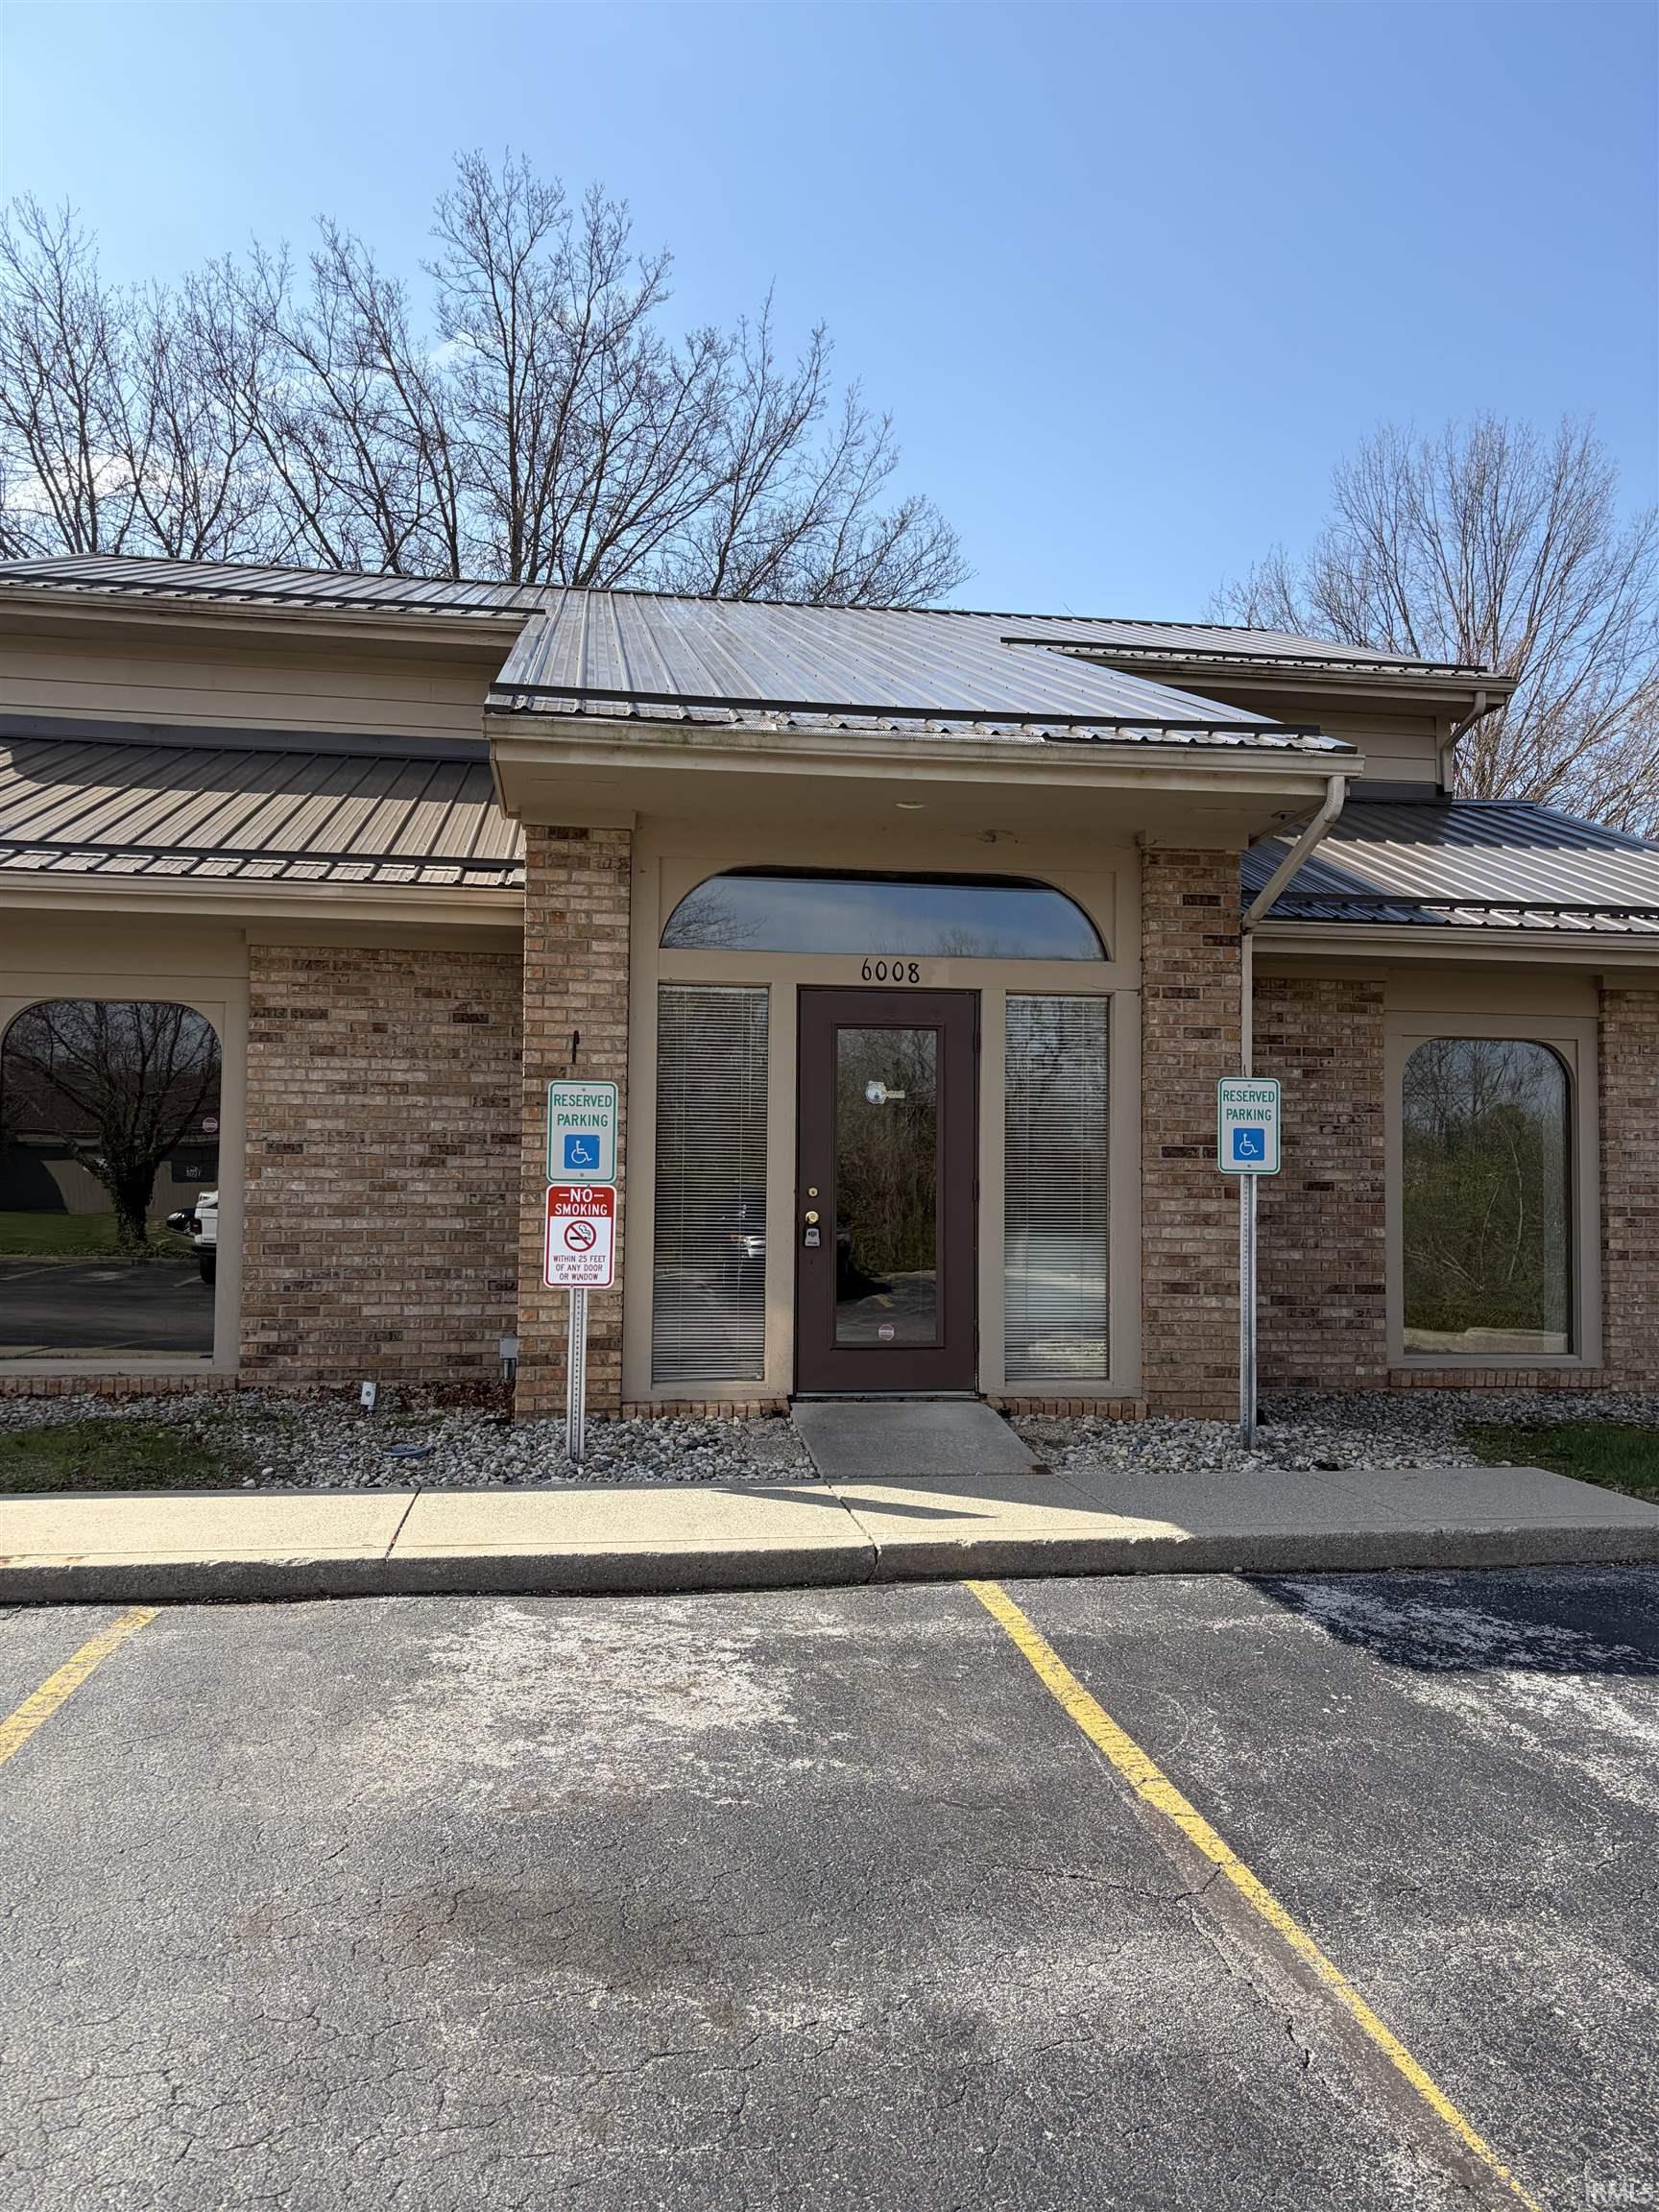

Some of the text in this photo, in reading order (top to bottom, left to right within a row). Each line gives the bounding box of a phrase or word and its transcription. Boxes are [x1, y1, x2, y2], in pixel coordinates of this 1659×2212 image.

[862, 958, 920, 983] 6008
[553, 1094, 613, 1107] RESERVED
[1222, 1090, 1275, 1103] RESERVED
[557, 1114, 609, 1127] PARKING
[1226, 1108, 1272, 1121] PARKING
[554, 1203, 608, 1216] SMOKING
[553, 1254, 606, 1263] WITHIN 25 FEET
[555, 1263, 603, 1272] OF ANY DOOR
[559, 1272, 599, 1282] OR WINDOW
